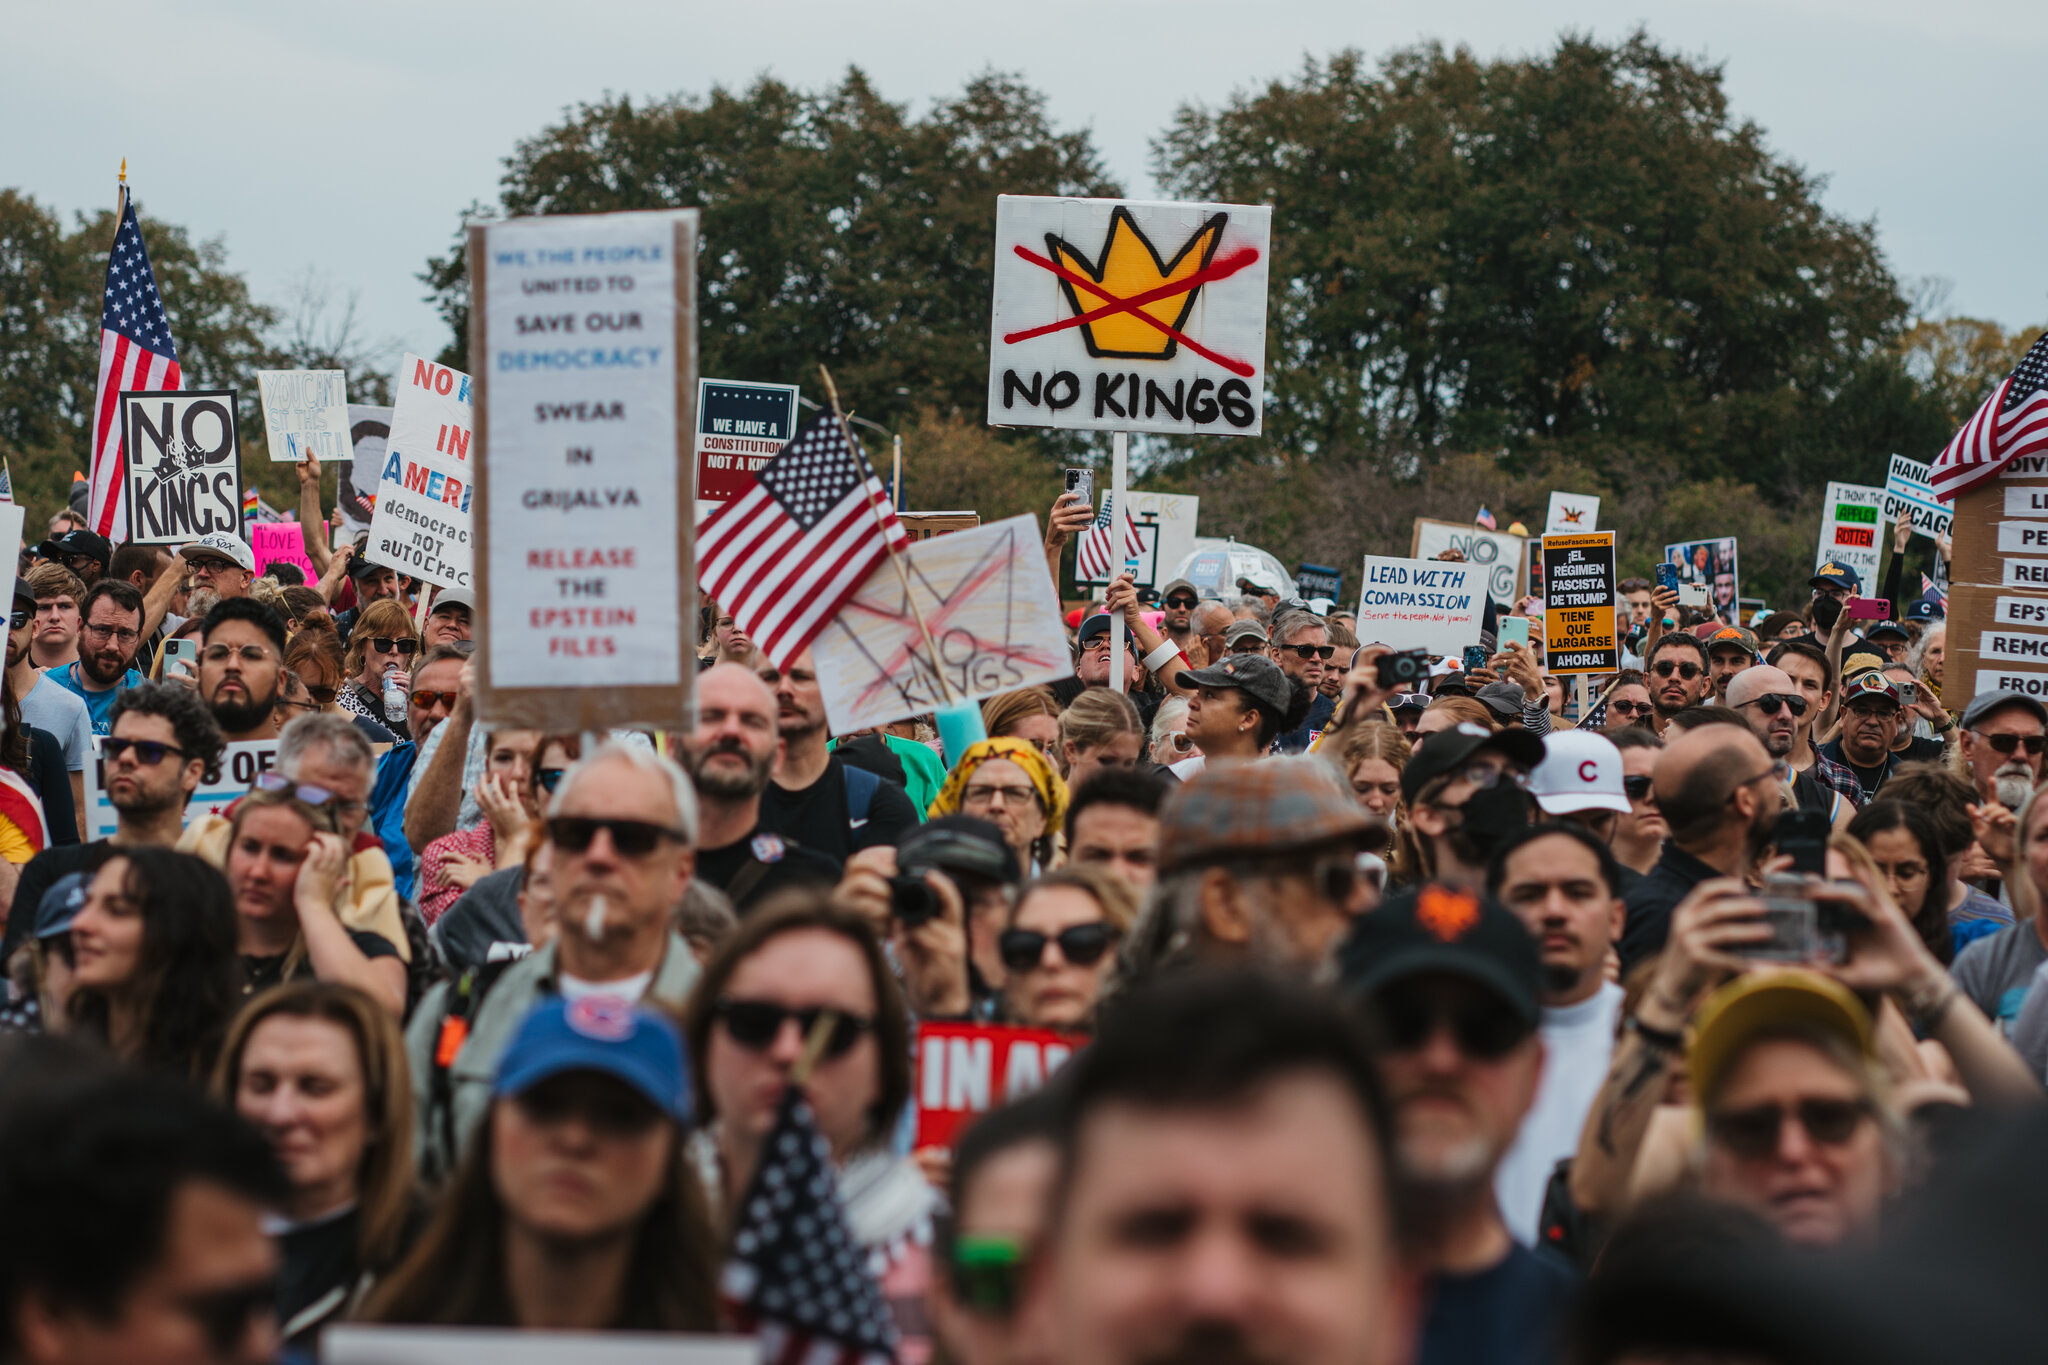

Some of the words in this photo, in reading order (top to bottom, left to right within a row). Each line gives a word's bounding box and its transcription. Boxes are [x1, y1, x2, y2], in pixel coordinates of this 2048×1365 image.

[537, 249, 575, 263] THE
[584, 246, 661, 263] PEOPLE
[521, 278, 601, 295] UNITED
[607, 275, 635, 292] TO
[516, 315, 576, 335] SAVE
[586, 312, 642, 332] OUR
[498, 347, 661, 371] DEMOCRACY
[413, 359, 454, 396] NO
[1003, 370, 1080, 409] NO
[1094, 373, 1255, 427] KINGS
[535, 402, 625, 423] SWEAR
[131, 400, 233, 465] NO
[713, 418, 733, 433] WE
[735, 420, 766, 436] HAVE
[769, 422, 778, 436] A
[436, 424, 471, 461] IN
[704, 437, 784, 454] CONSTITUTION
[566, 447, 593, 466] IN
[707, 455, 733, 470] NOT
[735, 457, 745, 471] A
[747, 458, 773, 472] KIN
[2007, 456, 2048, 472] DIV
[135, 471, 236, 539] KINGS
[522, 488, 640, 513] GRIJALVA
[1835, 488, 1841, 500] I
[1869, 491, 1883, 504] THE
[260, 532, 296, 549] LOVE
[1547, 538, 1608, 546] RefuseFascism.org
[1836, 528, 1874, 547] ROTTEN
[527, 547, 637, 570] RELEASE
[1450, 534, 1499, 564] NO
[1568, 550, 1586, 563] ¡EL
[1825, 550, 1852, 562] RIGHT
[1853, 553, 1860, 564] 2
[1862, 554, 1877, 565] THE
[1370, 566, 1408, 584] LEAD
[1413, 569, 1466, 588] WITH
[1554, 563, 1605, 577] RÉGIMEN
[557, 578, 606, 598] THE
[1551, 579, 1606, 591] FASCISTA
[1364, 590, 1471, 610] COMPASSION
[1550, 594, 1565, 606] DE
[1566, 592, 1608, 605] TRUMP
[1921, 603, 1931, 614] C
[530, 607, 636, 629] EPSTEIN
[1363, 610, 1390, 620] Serve
[1392, 612, 1408, 620] the
[1560, 611, 1595, 622] TIENE
[1566, 624, 1591, 636] QUE
[549, 637, 616, 657] FILES
[1550, 636, 1612, 649] LARGARSE
[904, 628, 977, 688] NO
[1556, 654, 1605, 667] AHORA!
[1578, 760, 1597, 782] C
[922, 1035, 993, 1113] IN
